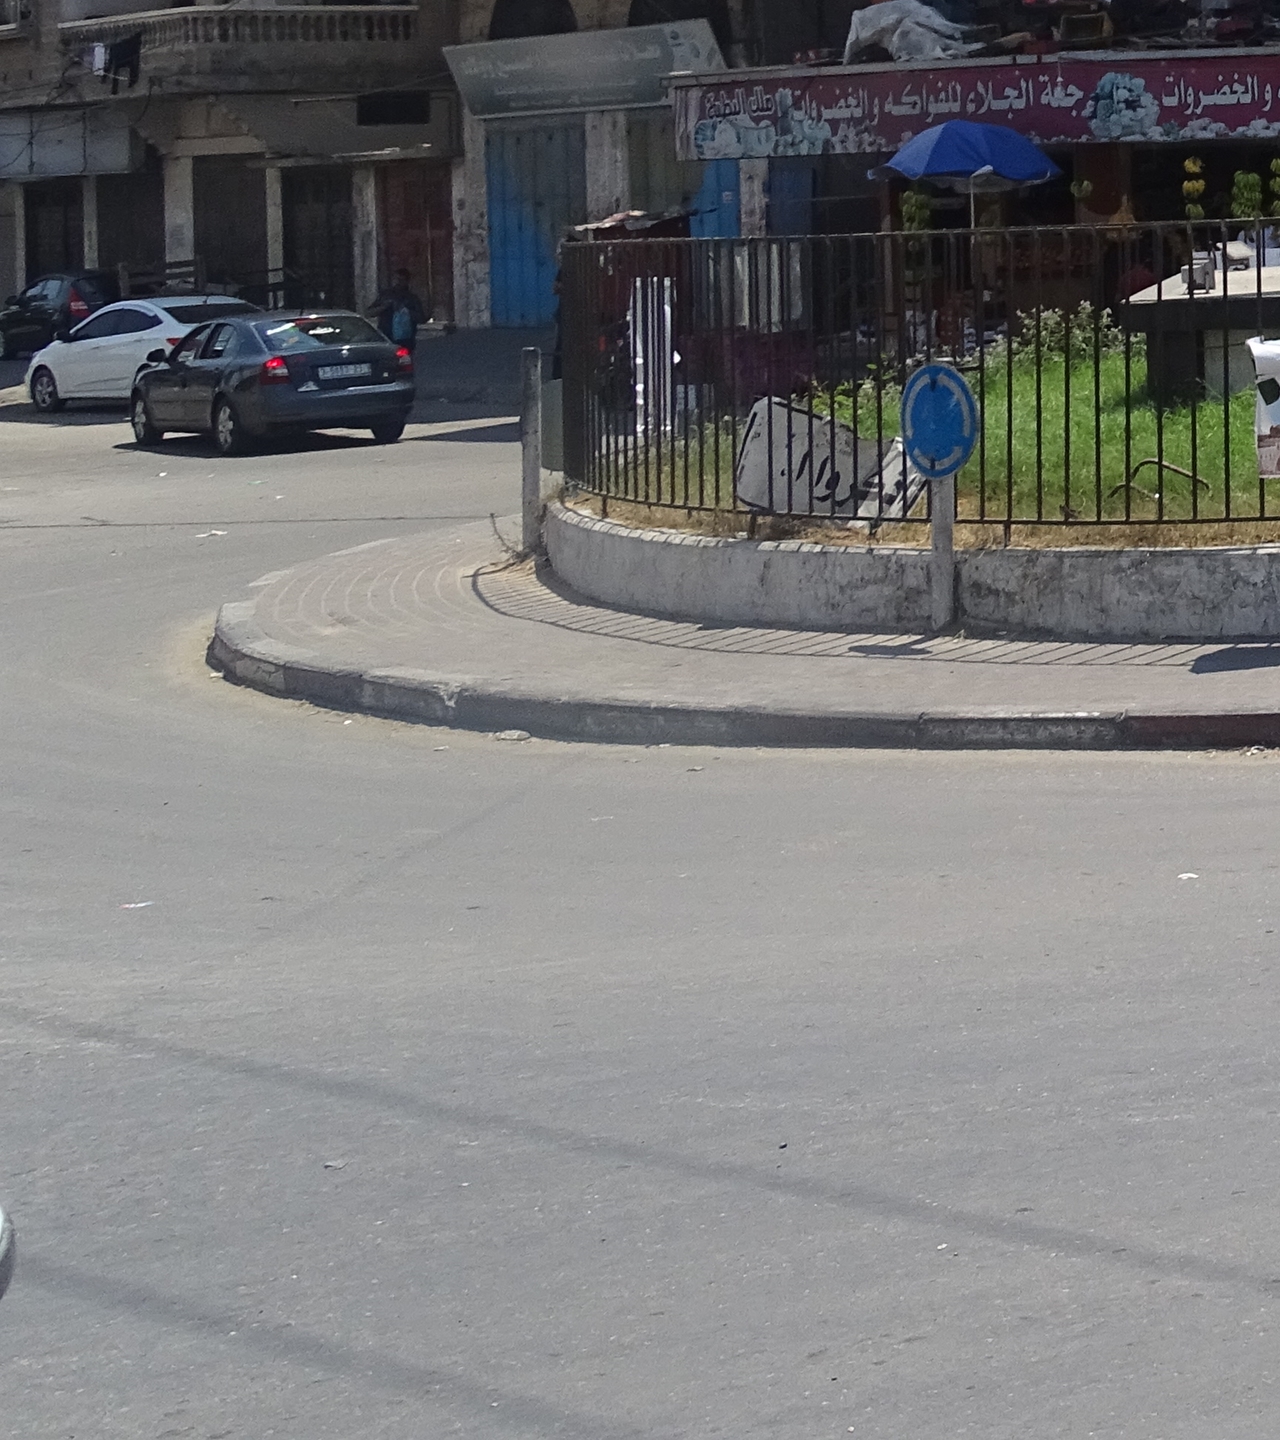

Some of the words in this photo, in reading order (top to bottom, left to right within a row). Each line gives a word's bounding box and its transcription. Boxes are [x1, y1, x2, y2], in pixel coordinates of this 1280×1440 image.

[884, 78, 962, 123] للفواكه
[966, 77, 1034, 120] الجلاء
[1161, 72, 1259, 115] الخضروات
[1263, 84, 1273, 112] و
